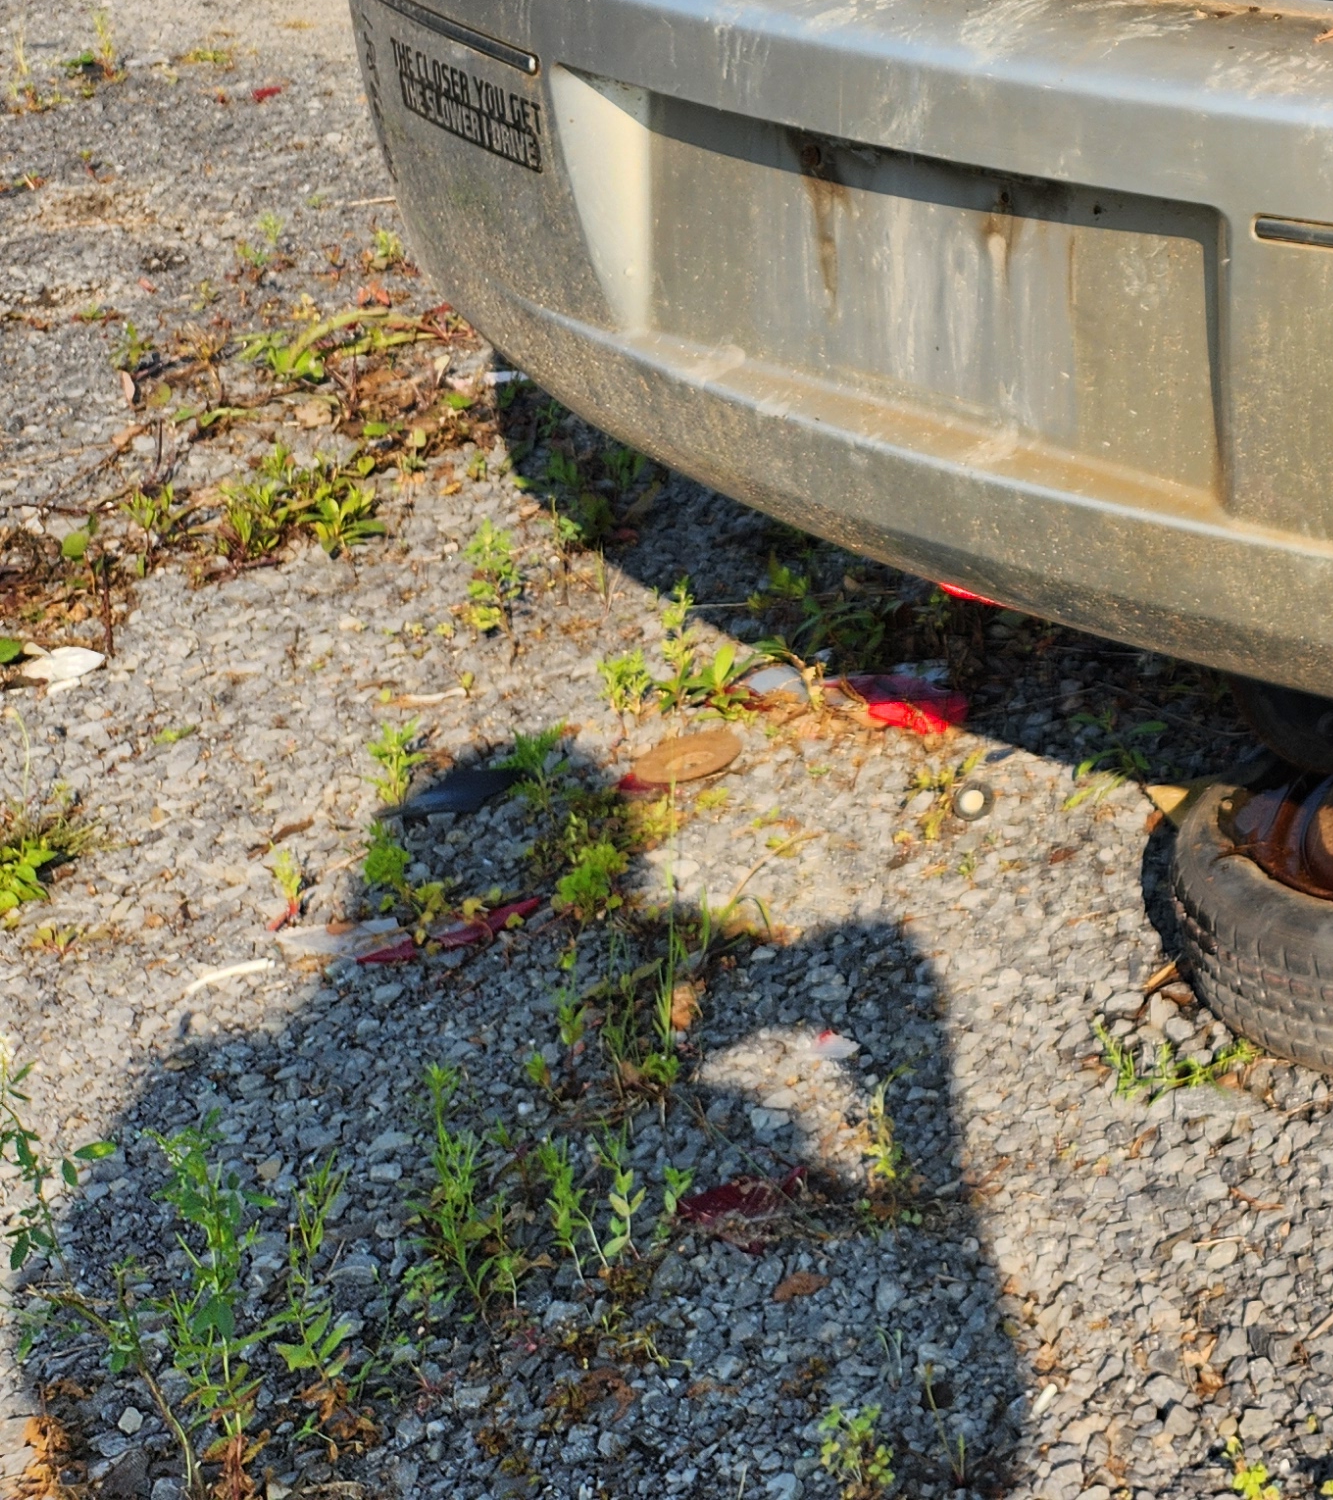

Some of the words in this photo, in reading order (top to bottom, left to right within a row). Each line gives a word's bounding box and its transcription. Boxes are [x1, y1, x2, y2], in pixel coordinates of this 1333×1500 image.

[389, 36, 414, 76] THE
[415, 49, 470, 105] CLOSER
[472, 75, 506, 120] YOU
[509, 91, 542, 137] GET
[402, 74, 426, 113] THE
[425, 86, 481, 143] SLOWER
[490, 116, 539, 171] DRIVE
